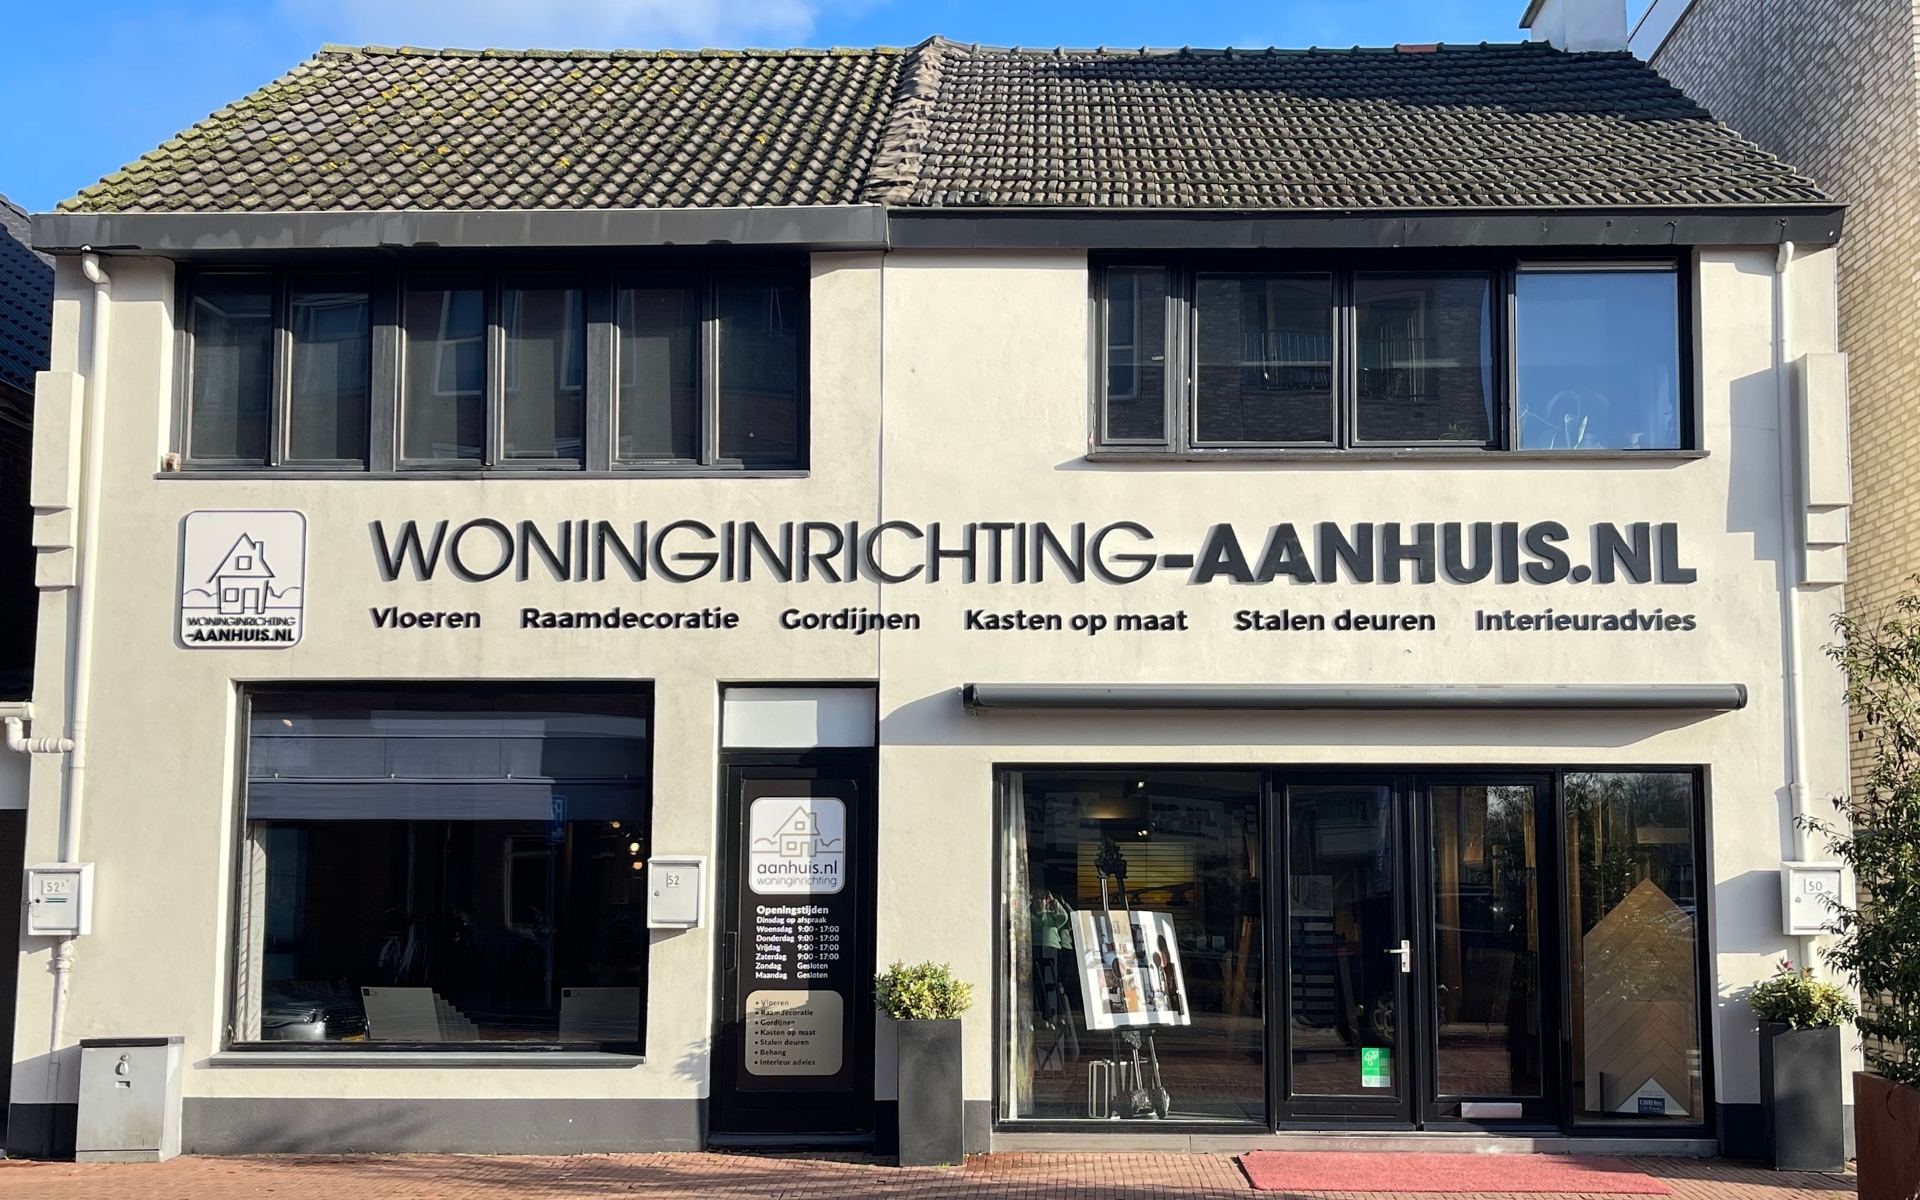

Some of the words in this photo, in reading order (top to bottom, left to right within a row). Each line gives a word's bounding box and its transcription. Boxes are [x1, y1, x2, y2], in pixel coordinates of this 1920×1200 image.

[368, 517, 1697, 584] WONINGINRICHTING-AANHUIS.NL
[186, 616, 296, 626] WONINGINRICHTING
[369, 606, 481, 629] Vloeren
[520, 606, 739, 629] Raamdecoratie
[779, 607, 921, 635] Gordijnen
[964, 608, 1061, 631] Kasten
[1068, 613, 1107, 636] op
[1114, 609, 1188, 631] maat
[1233, 608, 1325, 632] Stalen
[1334, 608, 1436, 632] deuren
[1474, 607, 1697, 632] Interieuradvies
[185, 628, 295, 642] -AANHUIS.NL
[757, 860, 837, 875] aanhuis.nl
[668, 875, 680, 885] 52
[757, 876, 837, 887] woninginrichting
[1808, 881, 1823, 891] 50
[756, 905, 829, 916] Openingstijden
[756, 916, 785, 924] Dinsdag
[797, 916, 827, 924] afspraak
[756, 926, 793, 934] Woensdag
[756, 935, 795, 943] Donderdag
[755, 944, 781, 952] Vrijdag
[755, 953, 787, 961] Zaterdag
[755, 962, 782, 970] Zondag
[755, 971, 787, 980] Maandag
[797, 971, 828, 979] Gesloten
[760, 1019, 795, 1027] Gordijnen
